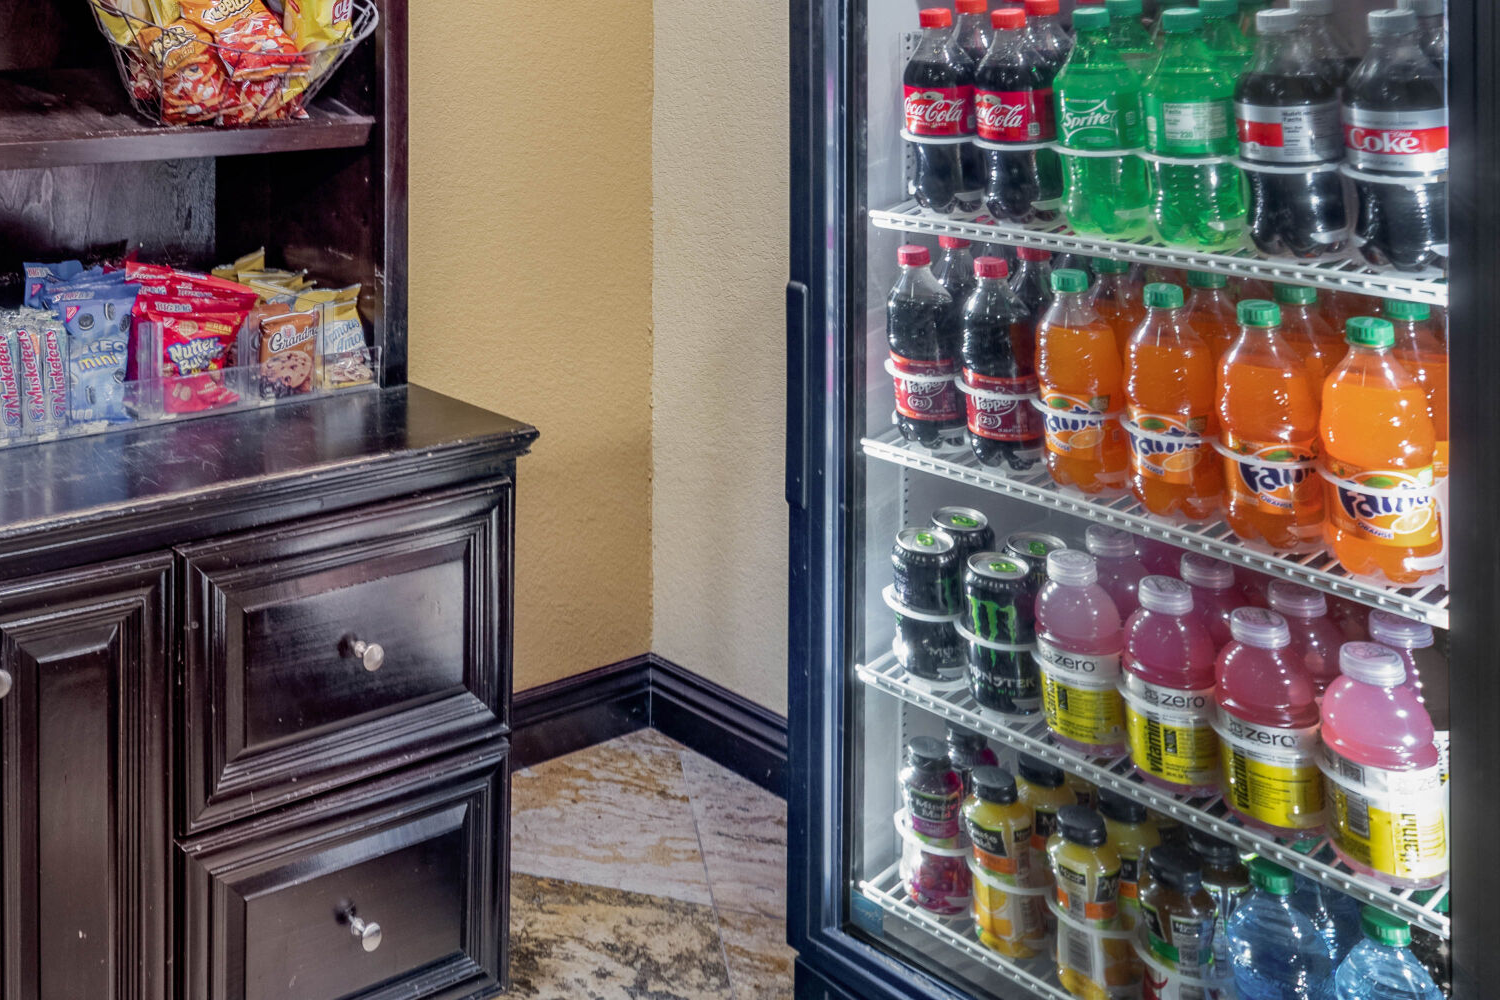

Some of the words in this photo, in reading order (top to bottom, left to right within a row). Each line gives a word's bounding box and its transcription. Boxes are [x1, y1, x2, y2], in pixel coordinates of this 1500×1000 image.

[1062, 111, 1110, 129] Sprite
[1350, 128, 1420, 154] Coke
[324, 318, 360, 347] Famous
[78, 351, 119, 370] mini
[169, 338, 216, 363] Nutter
[17, 330, 44, 405] Musketeers
[45, 331, 67, 403] Musketeers
[1260, 495, 1294, 510] ORANGE
[1357, 522, 1394, 540] ORANGE
[1054, 654, 1096, 673] zero
[1161, 694, 1205, 709] zero
[1147, 711, 1163, 773] vitamin
[1245, 726, 1296, 748] zero
[1232, 744, 1250, 810] vitamin
